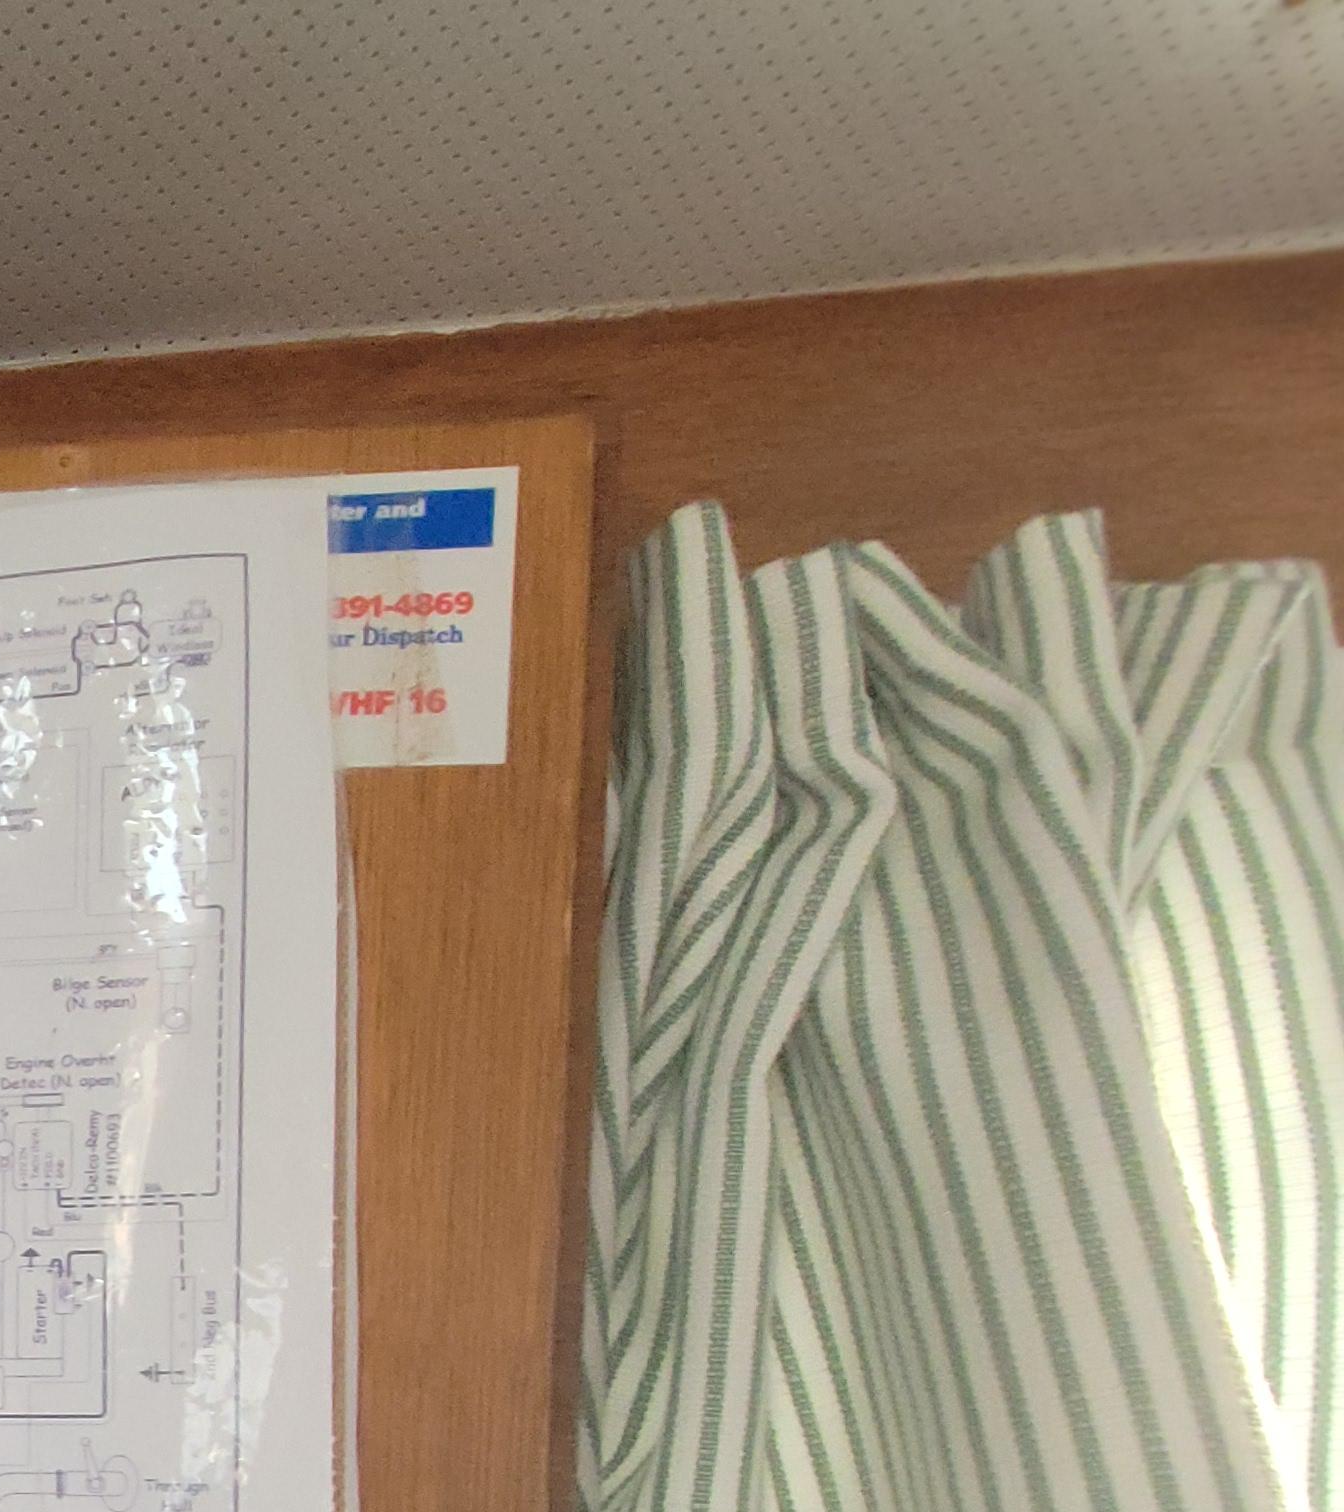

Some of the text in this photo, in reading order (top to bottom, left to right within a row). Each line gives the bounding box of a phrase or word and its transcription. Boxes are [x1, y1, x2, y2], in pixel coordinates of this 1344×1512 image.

[374, 497, 426, 520] and
[363, 620, 464, 650] Dispatch
[410, 687, 448, 714] 16
[97, 975, 148, 990] Sensor
[5, 1056, 54, 1072] Engine
[32, 1289, 48, 1345] Starter
